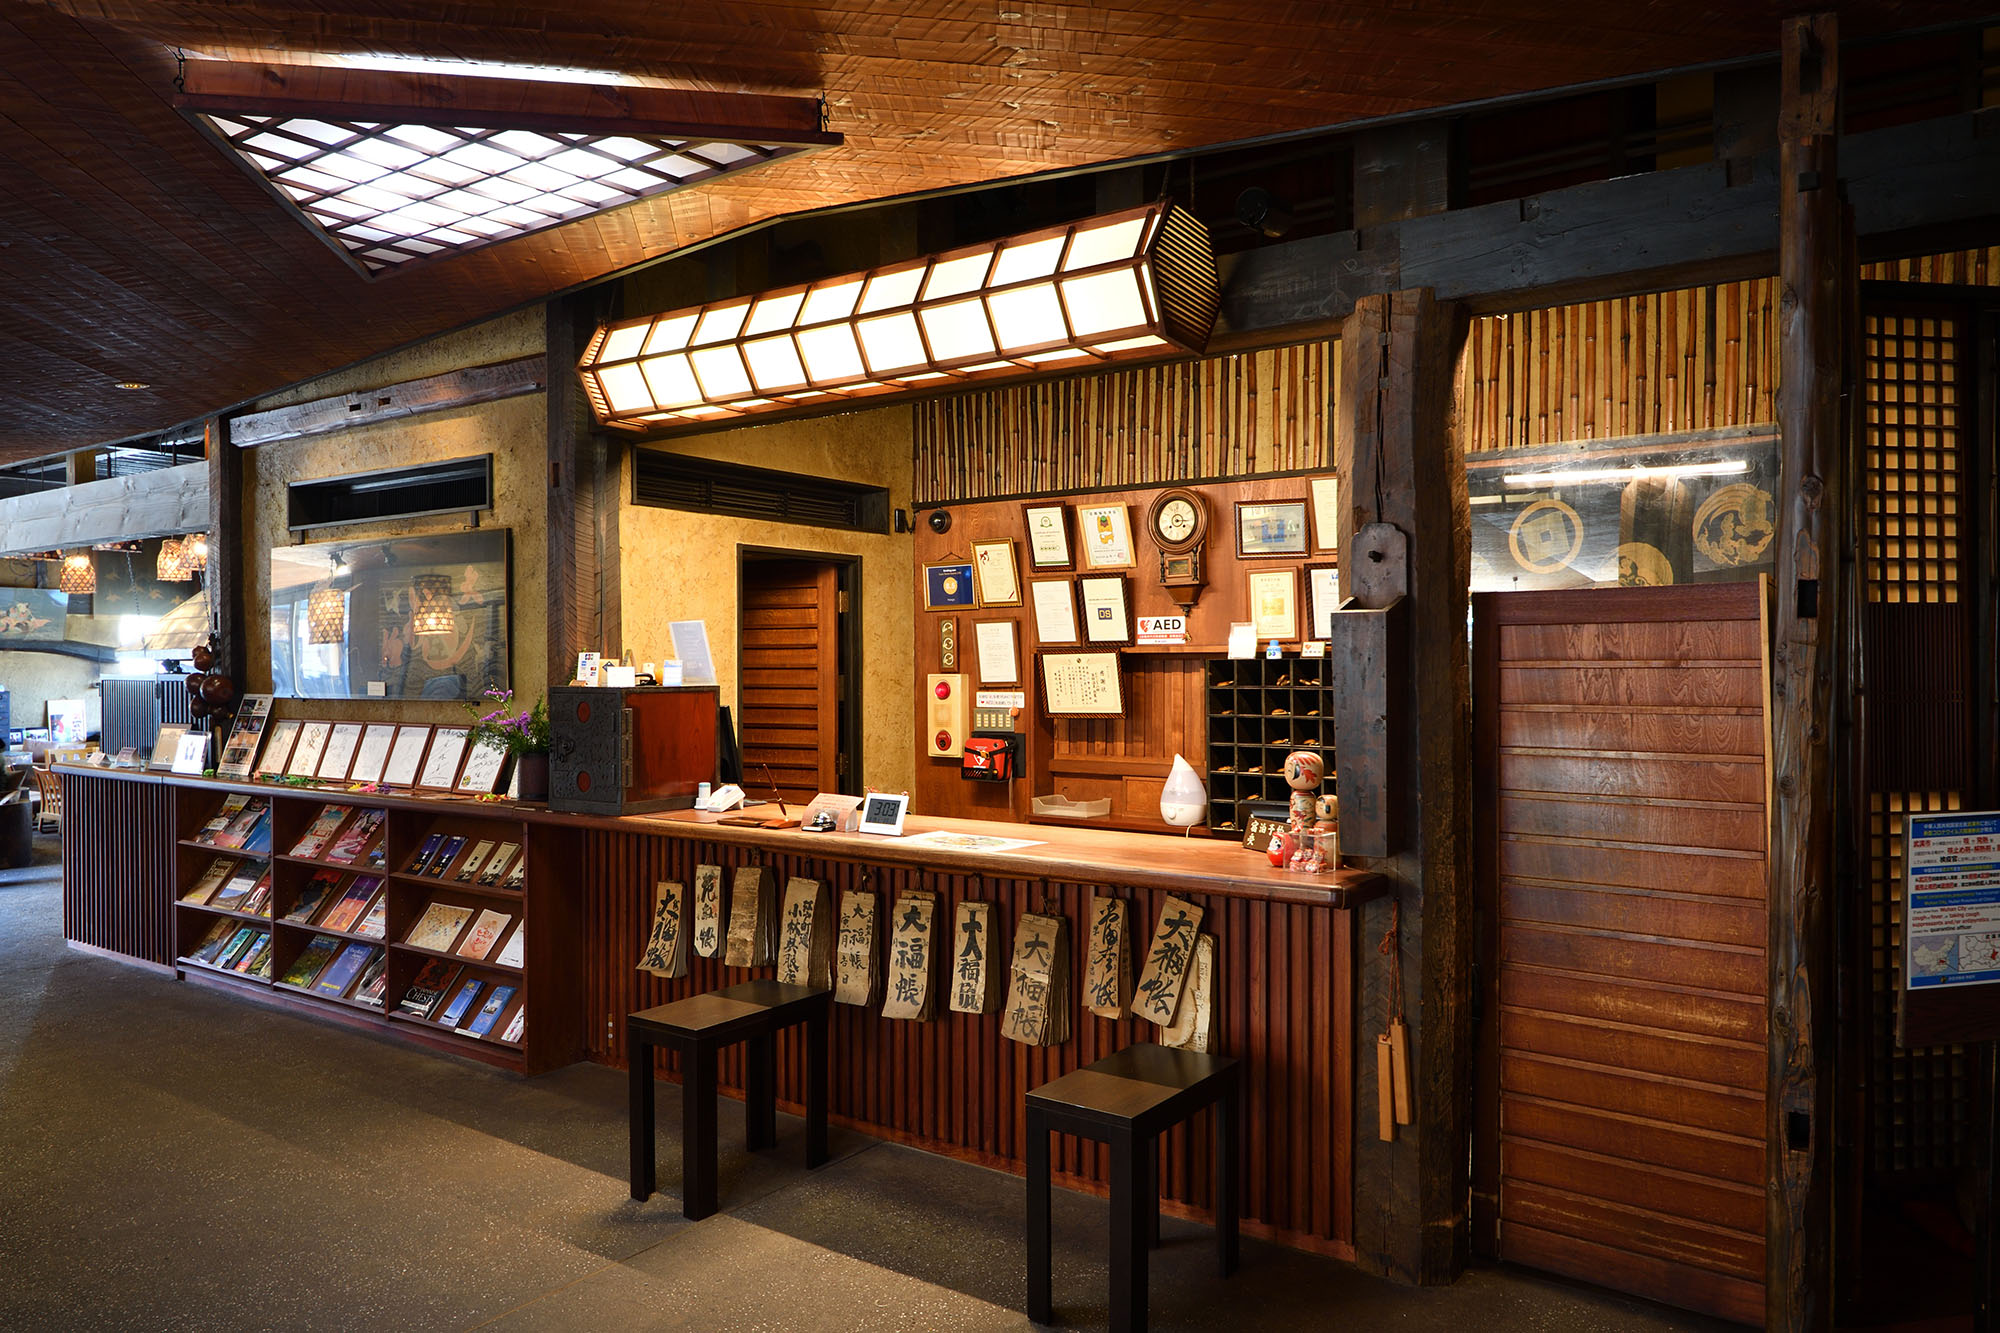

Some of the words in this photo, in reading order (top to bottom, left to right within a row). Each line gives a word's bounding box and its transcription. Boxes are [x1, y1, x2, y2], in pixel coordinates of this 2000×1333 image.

[1153, 619, 1182, 631] AED
[895, 906, 927, 1006] 大福帳
[1011, 932, 1049, 1040] 大福帳
